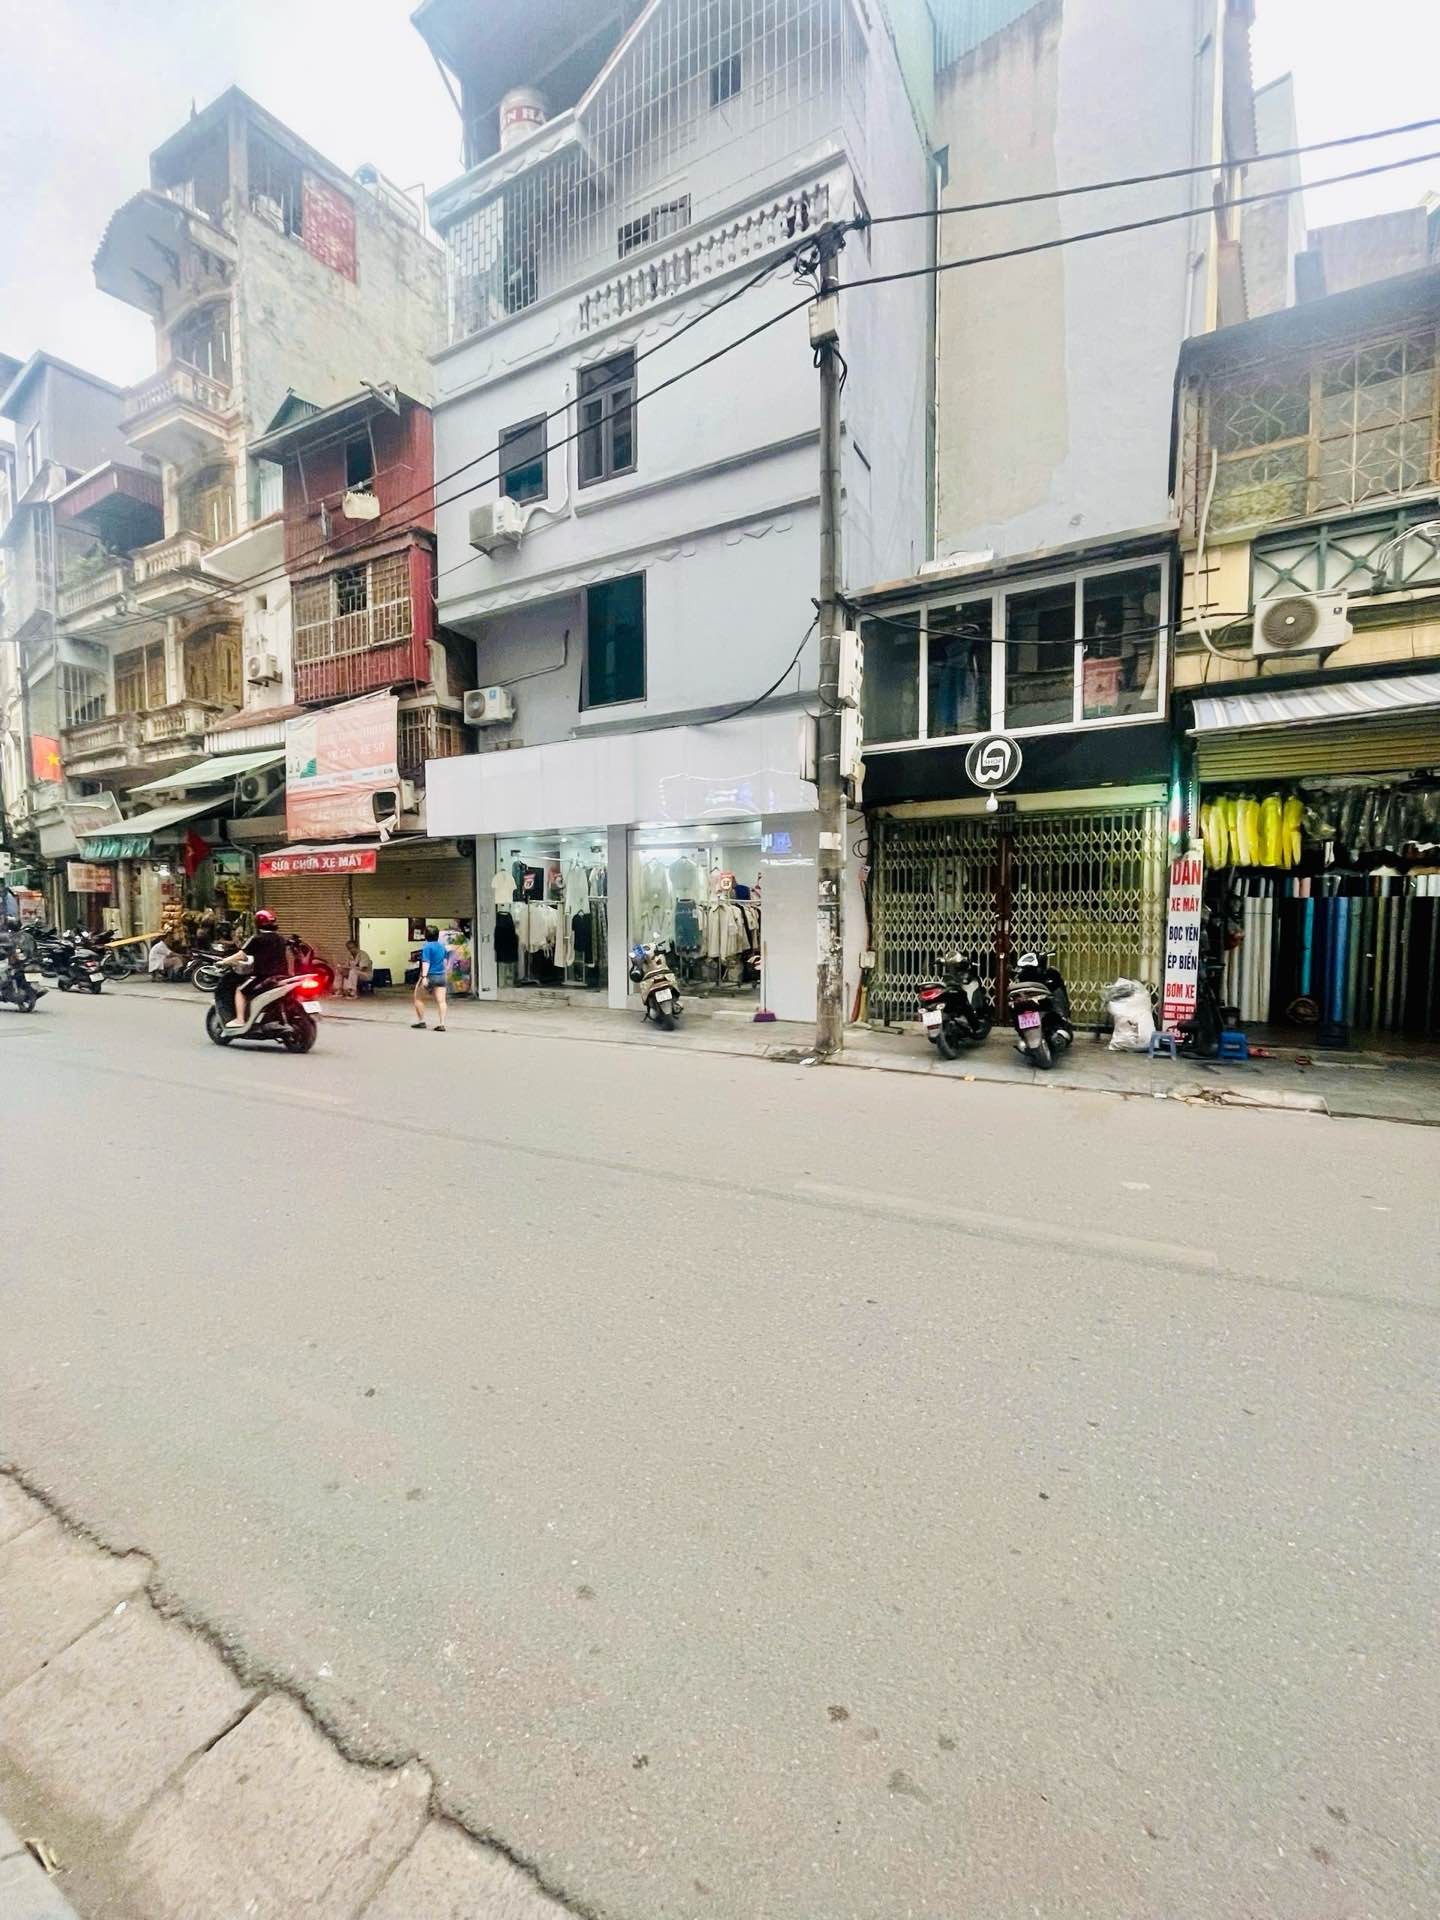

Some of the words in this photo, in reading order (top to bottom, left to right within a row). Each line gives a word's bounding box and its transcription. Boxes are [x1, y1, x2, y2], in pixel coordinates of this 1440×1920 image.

[321, 857, 336, 869] XE
[338, 853, 362, 867] MÁY
[1171, 897, 1181, 911] XE
[1183, 894, 1200, 912] MÁY
[1169, 926, 1183, 944] BỌC
[1185, 923, 1199, 941] YÊN
[1167, 951, 1177, 969] ÉP
[1185, 984, 1195, 998] XE
